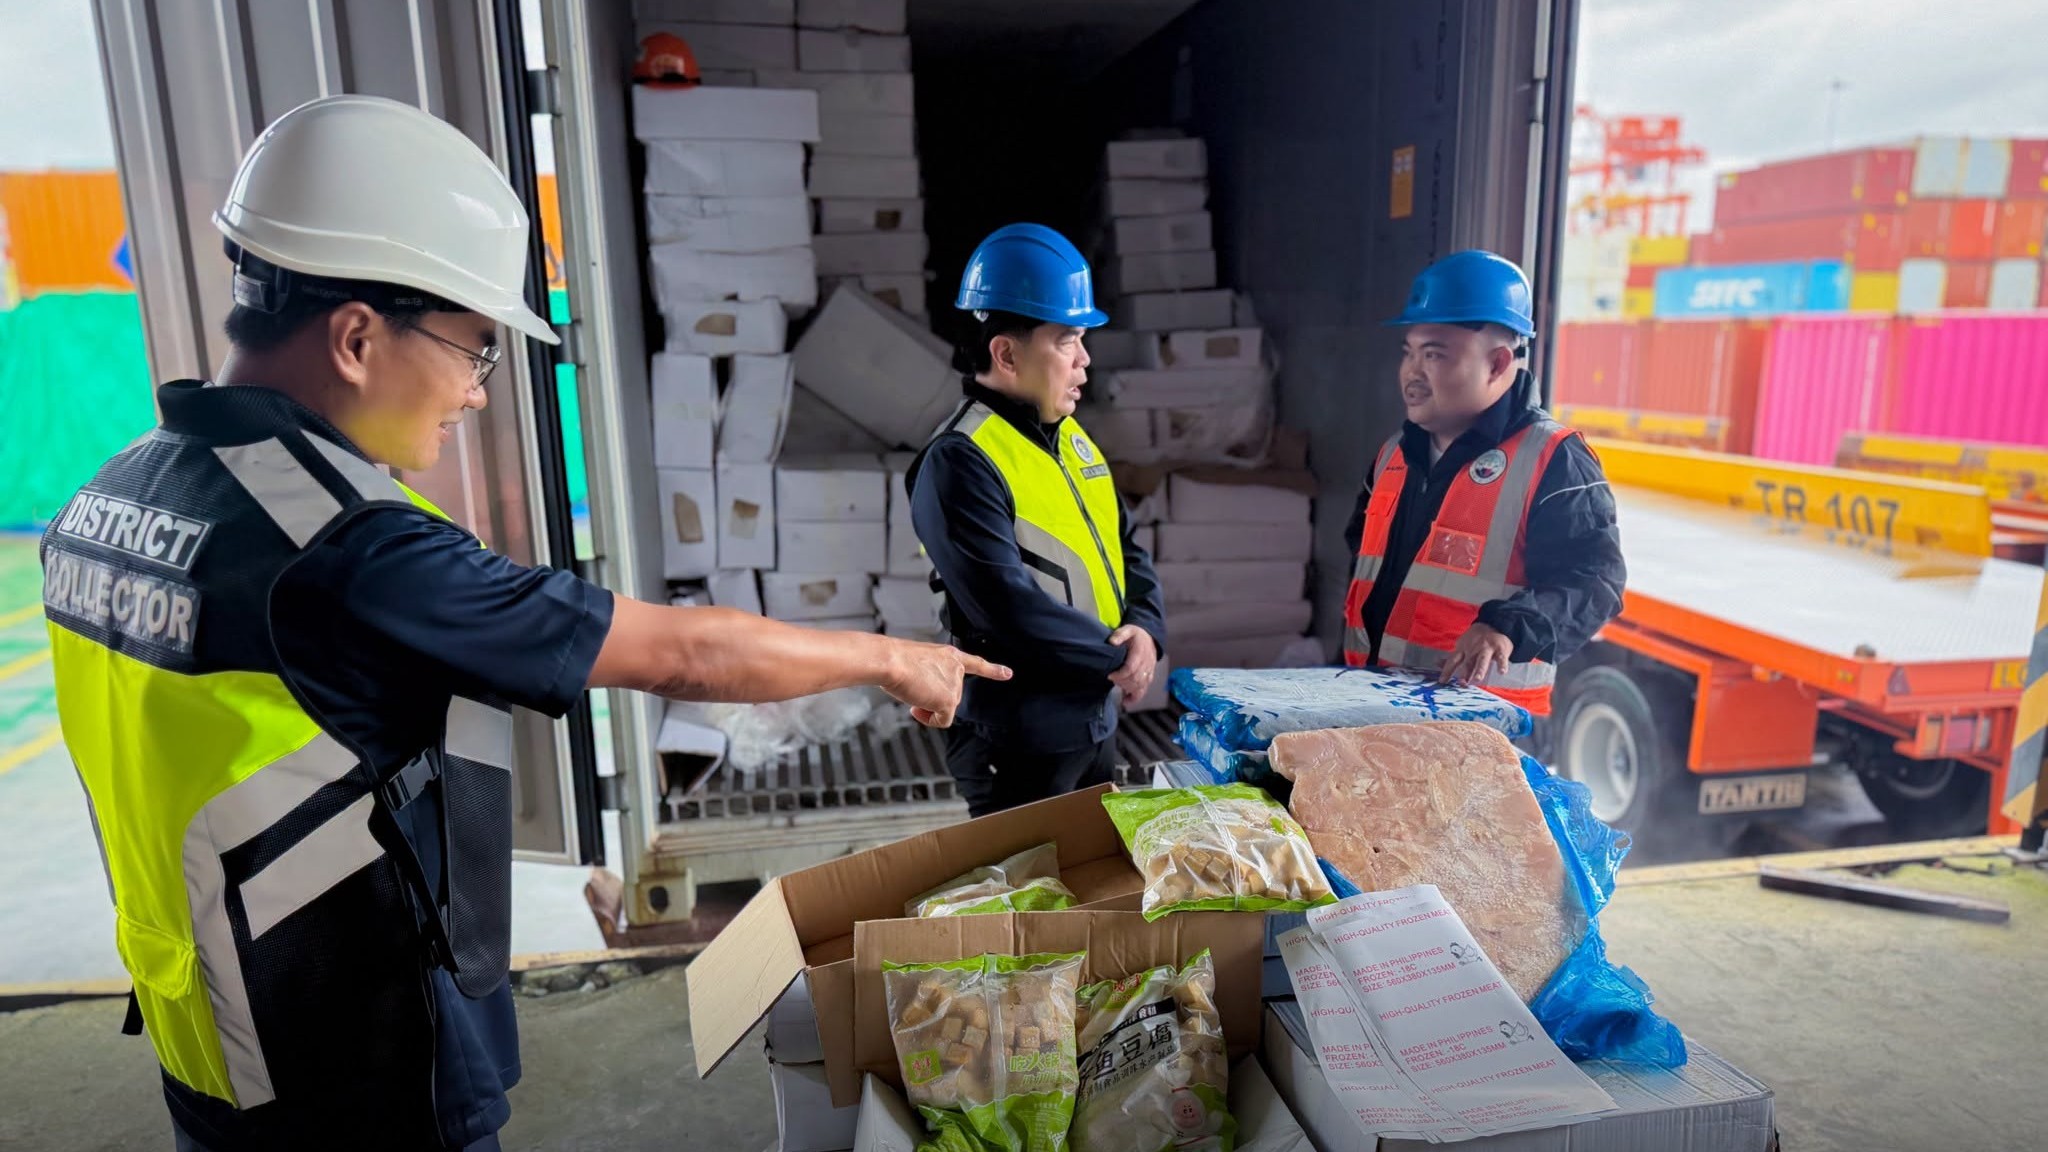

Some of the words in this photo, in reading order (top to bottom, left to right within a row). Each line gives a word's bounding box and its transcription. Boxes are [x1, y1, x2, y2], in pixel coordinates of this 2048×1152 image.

[1755, 479, 1807, 523] TR
[1826, 491, 1901, 544] 107
[61, 493, 203, 564] DISTRICT
[45, 551, 193, 643] COLLECTOR
[1314, 901, 1376, 924] HIGH-QUALITY
[1334, 921, 1395, 945] HIGH-QUALITY
[1395, 912, 1432, 928] FROZEN
[1295, 964, 1322, 977] MADE
[1352, 963, 1380, 978] MADE
[1380, 961, 1390, 969] IN
[1390, 946, 1445, 967] PHILIPPINES
[1398, 963, 1418, 974] -18C
[1362, 981, 1386, 994] SIZE:
[1378, 997, 1441, 1021] HIGH-QUALITY
[1441, 987, 1480, 1004] FROZEN
[1479, 981, 1503, 993] MEAT
[1322, 1044, 1351, 1054] MADE
[1399, 1043, 1426, 1057] MADE
[1428, 1042, 1438, 1050] IN
[1438, 1025, 1494, 1047] PHILIPPINES
[1431, 1074, 1495, 1094] HIGH-QUALITY
[1495, 1064, 1534, 1080] FROZEN
[1533, 1058, 1557, 1070] MEAT
